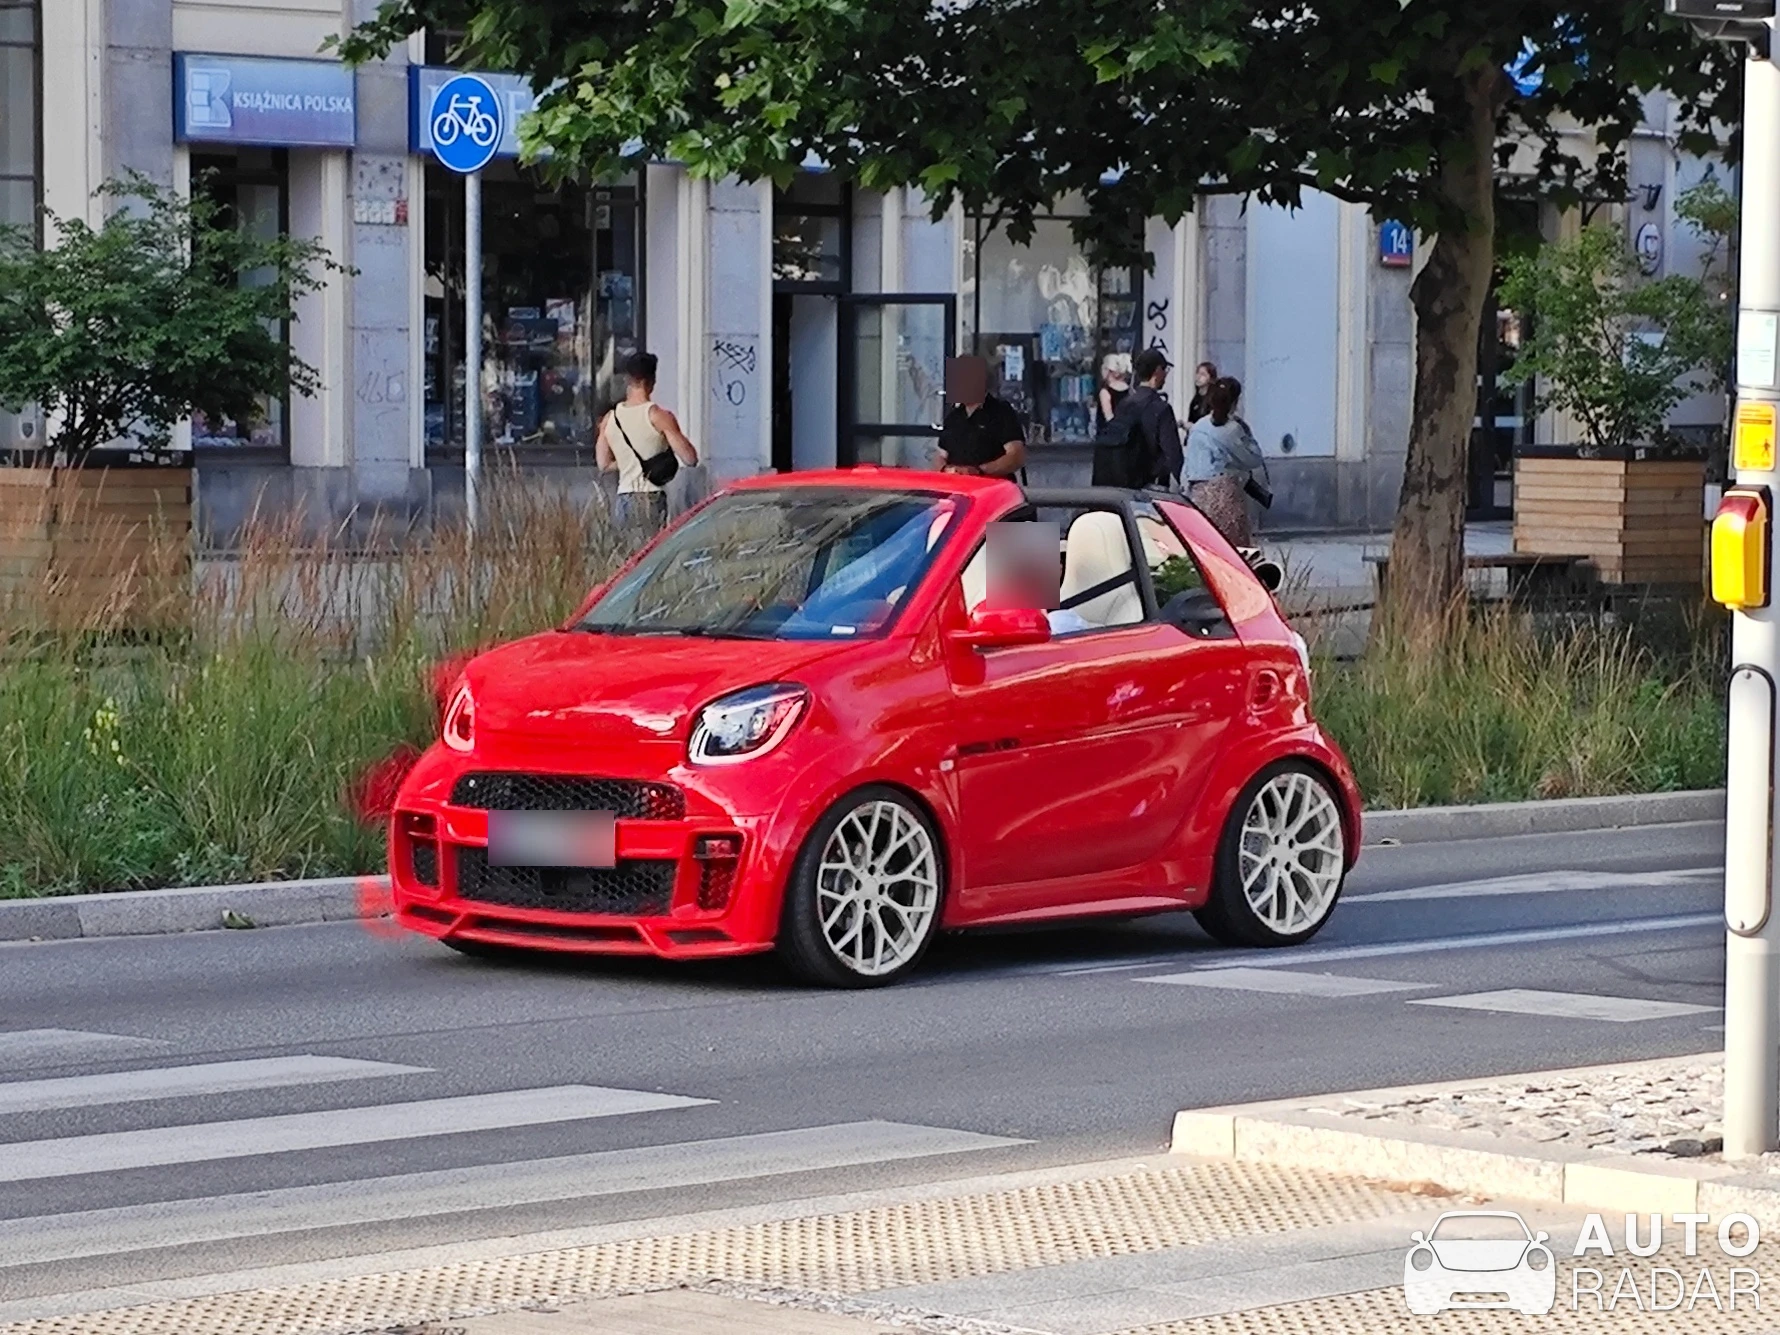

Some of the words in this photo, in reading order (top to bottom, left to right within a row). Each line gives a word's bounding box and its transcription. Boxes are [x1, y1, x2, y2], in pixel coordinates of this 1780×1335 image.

[233, 90, 301, 113] KSIĄŻNICA
[304, 95, 353, 113] POLSKA
[1390, 228, 1407, 254] 14
